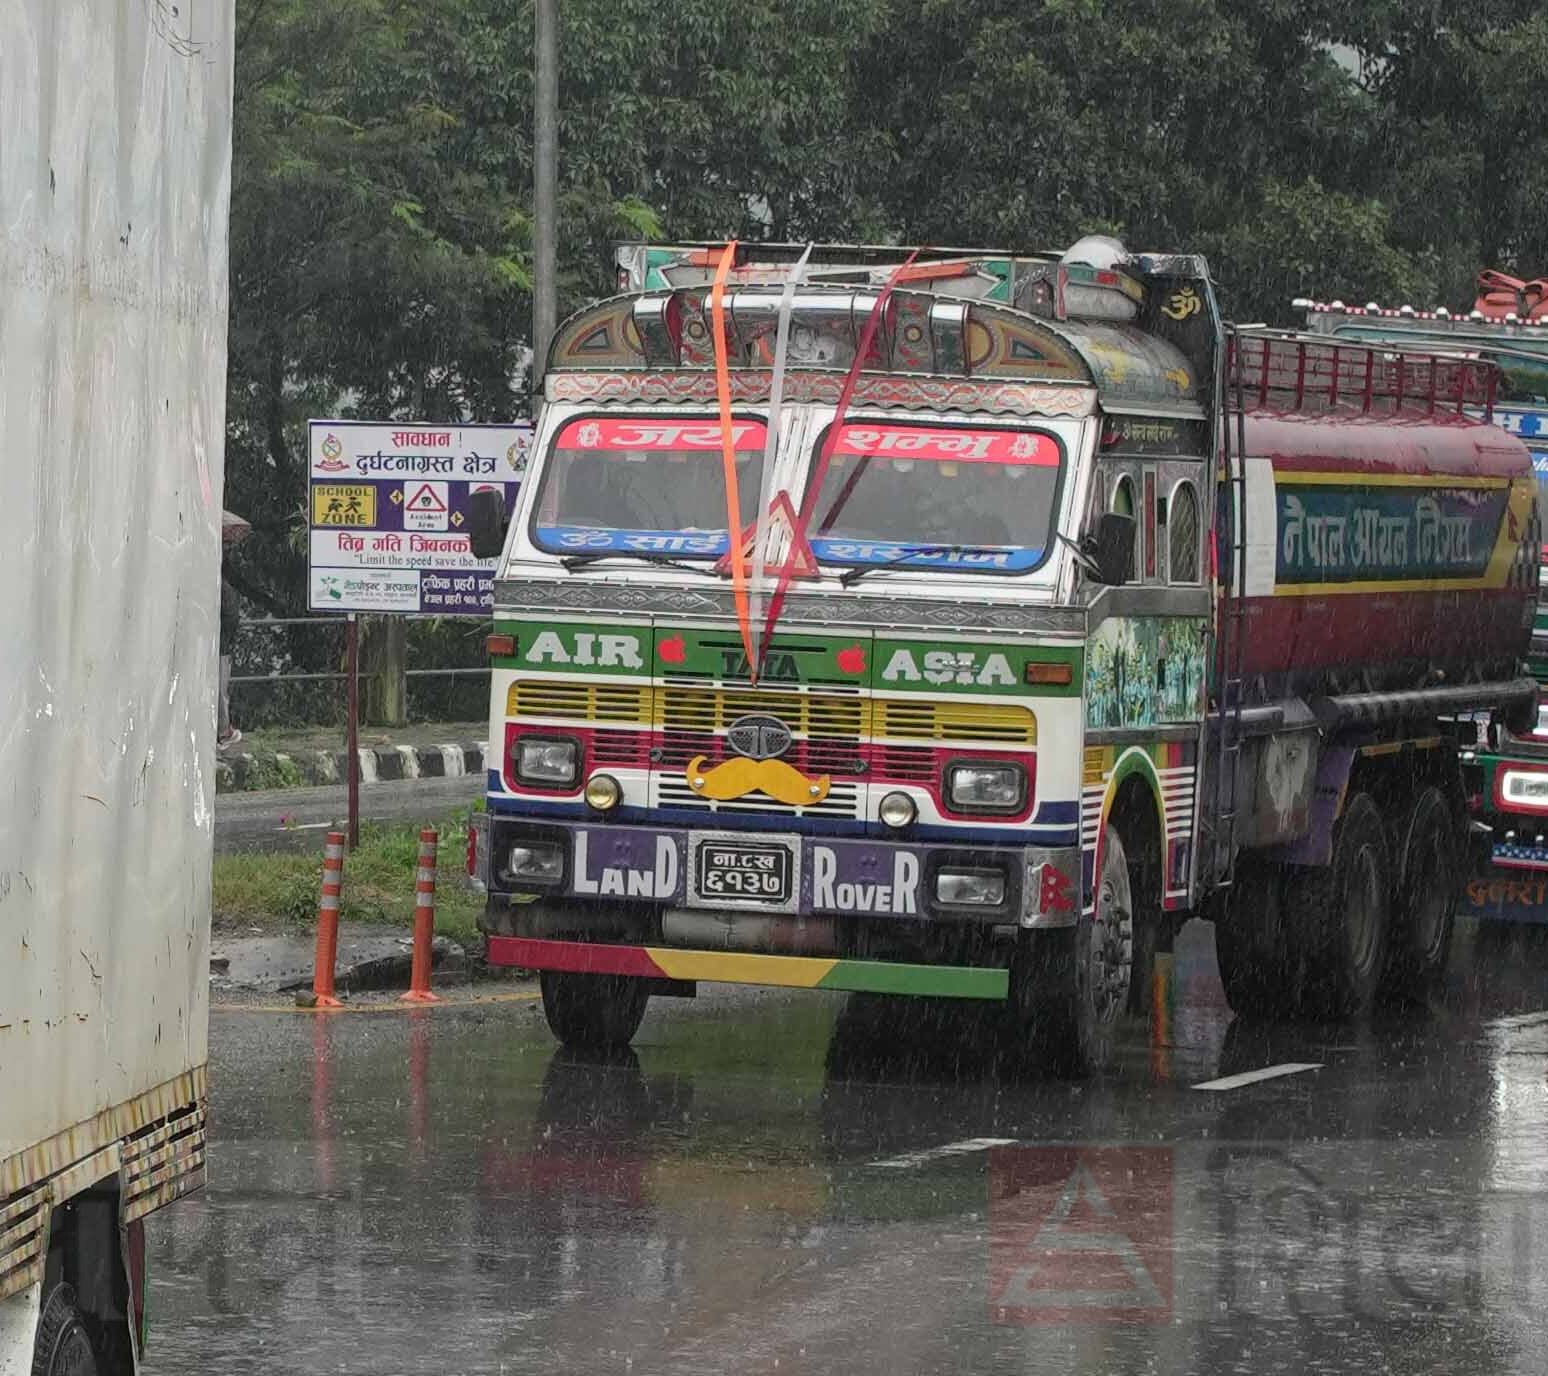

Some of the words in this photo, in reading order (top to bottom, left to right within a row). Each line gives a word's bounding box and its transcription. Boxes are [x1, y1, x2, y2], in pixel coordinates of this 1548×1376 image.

[391, 432, 452, 448] सावधान
[610, 425, 757, 446] जय
[356, 451, 455, 475] दुर्घटनाग्रस्त
[463, 452, 498, 474] क्षेत्र
[317, 488, 372, 497] SCHOOL
[321, 514, 368, 524] ZONE
[372, 534, 402, 552] गति
[388, 555, 403, 566] the
[406, 555, 432, 569] speed
[435, 557, 456, 567] save
[459, 556, 474, 567] the
[525, 631, 643, 668] AIR
[881, 649, 1017, 685] ASIA
[706, 870, 781, 893] ६१३७
